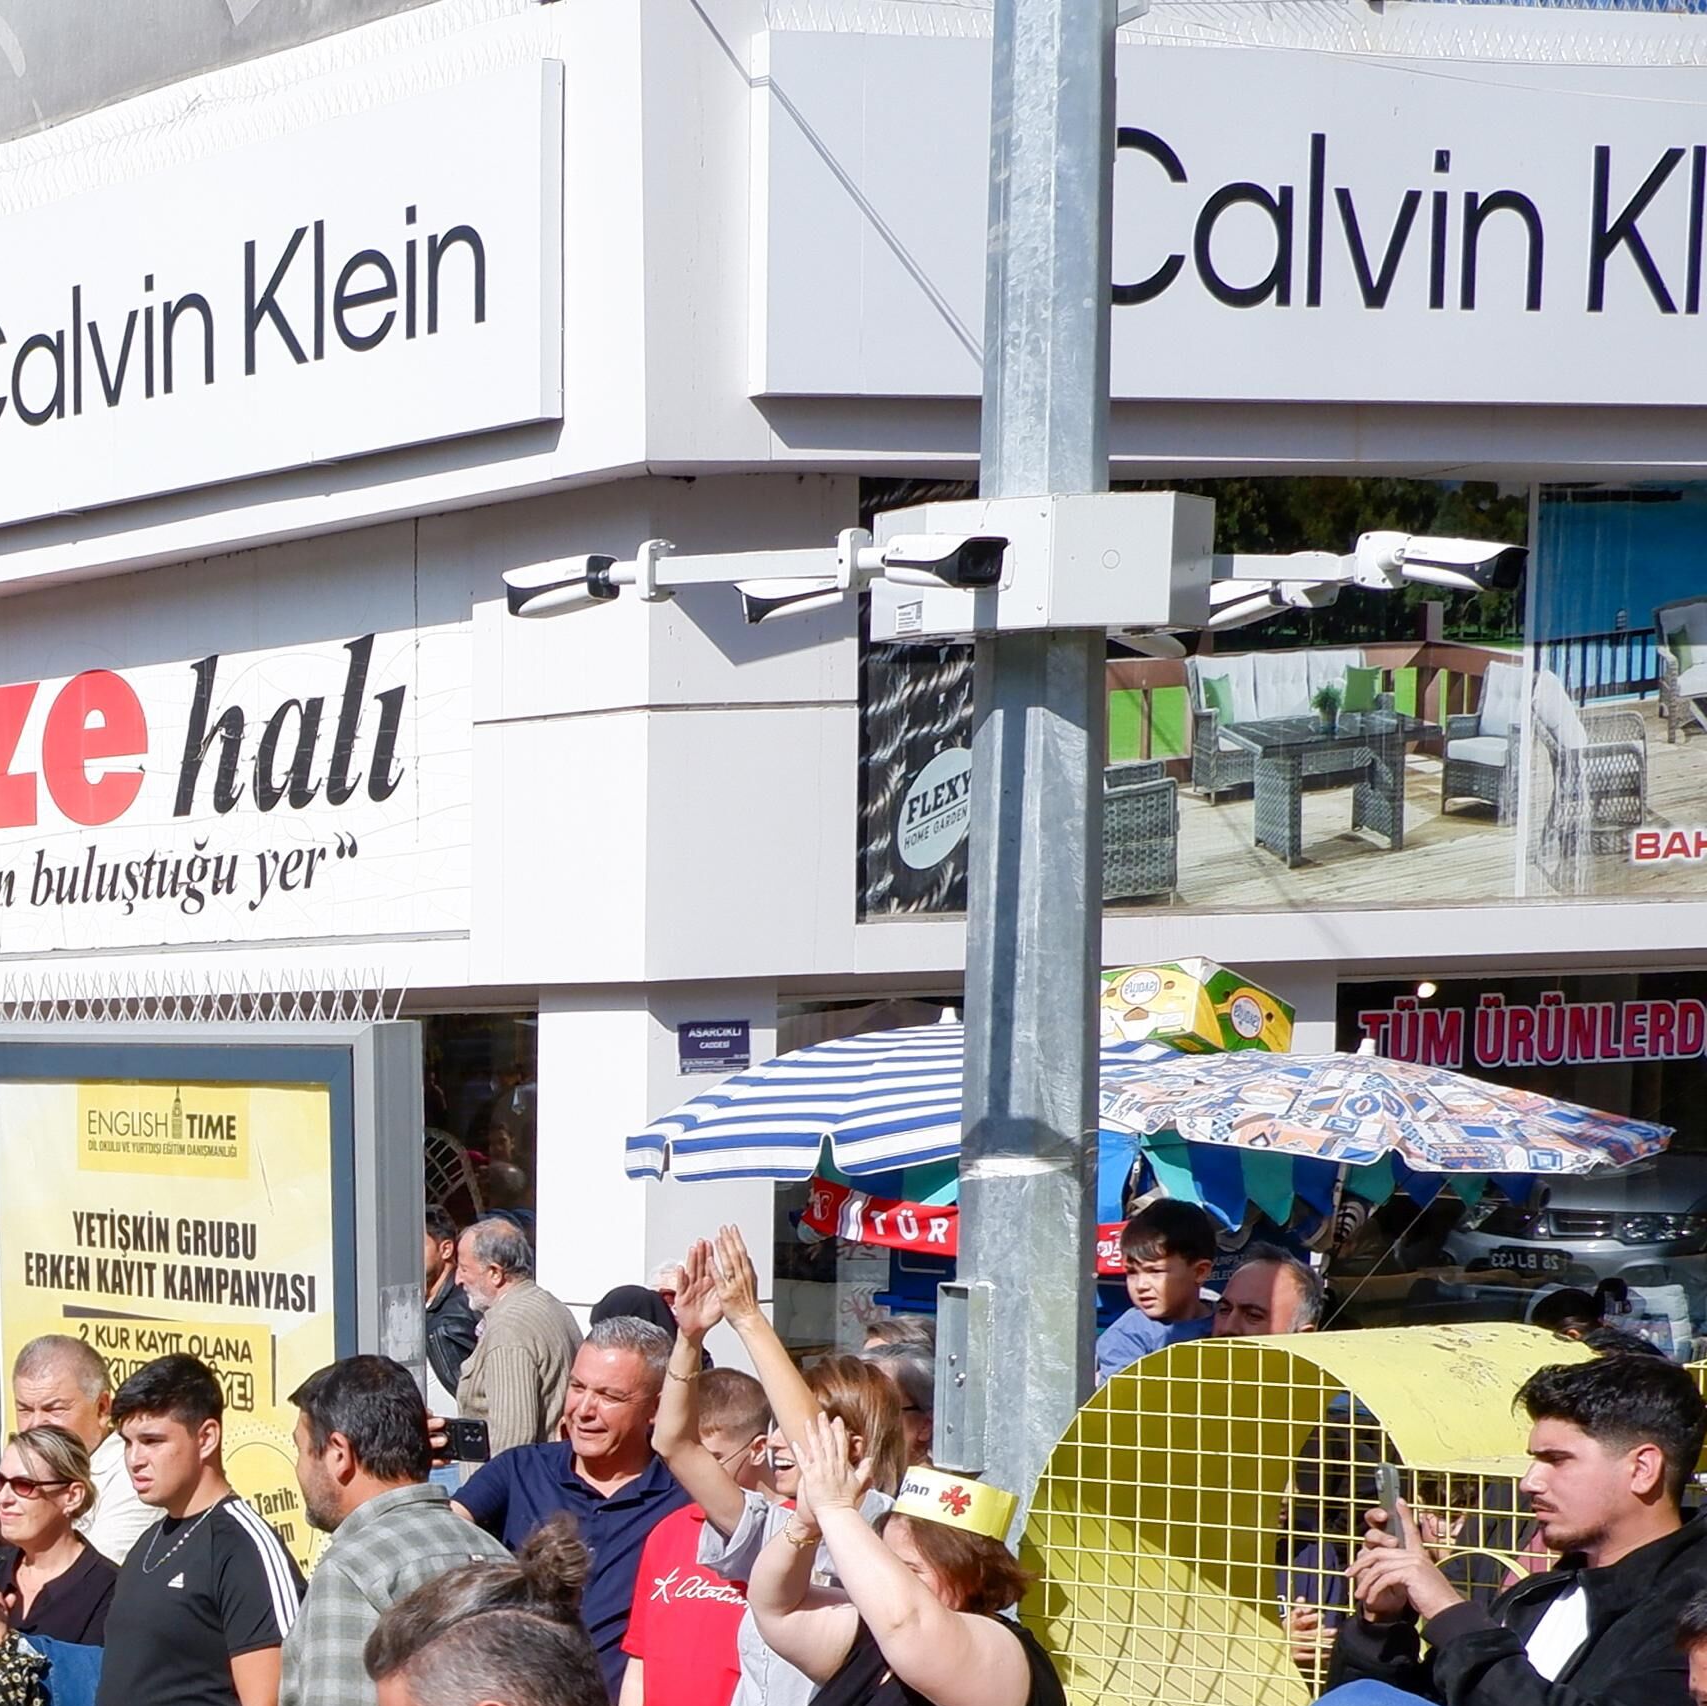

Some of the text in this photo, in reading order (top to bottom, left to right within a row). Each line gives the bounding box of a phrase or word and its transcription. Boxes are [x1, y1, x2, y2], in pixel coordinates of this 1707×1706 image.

[1586, 145, 1707, 315] Kl
[244, 204, 486, 376] Klein
[173, 632, 406, 818] halı
[906, 767, 972, 826] FLEXY
[904, 806, 968, 851] HOME GARDEN
[31, 835, 239, 916] buluştuğu
[1358, 991, 1707, 1069] TÜM ÜRÜNLERD
[88, 1110, 237, 1141] ENGLISH TIME
[99, 1140, 121, 1152] OKULU
[122, 1141, 131, 1153] VE
[72, 1208, 257, 1261] YETİŞKİN GRUBU
[871, 1210, 950, 1245] TÜR
[25, 1252, 316, 1313] ERKEN KAYIT KAMPANYASI
[79, 1323, 253, 1363] 2 KUR KAYIT OLANA
[254, 1487, 299, 1516] Tarih:
